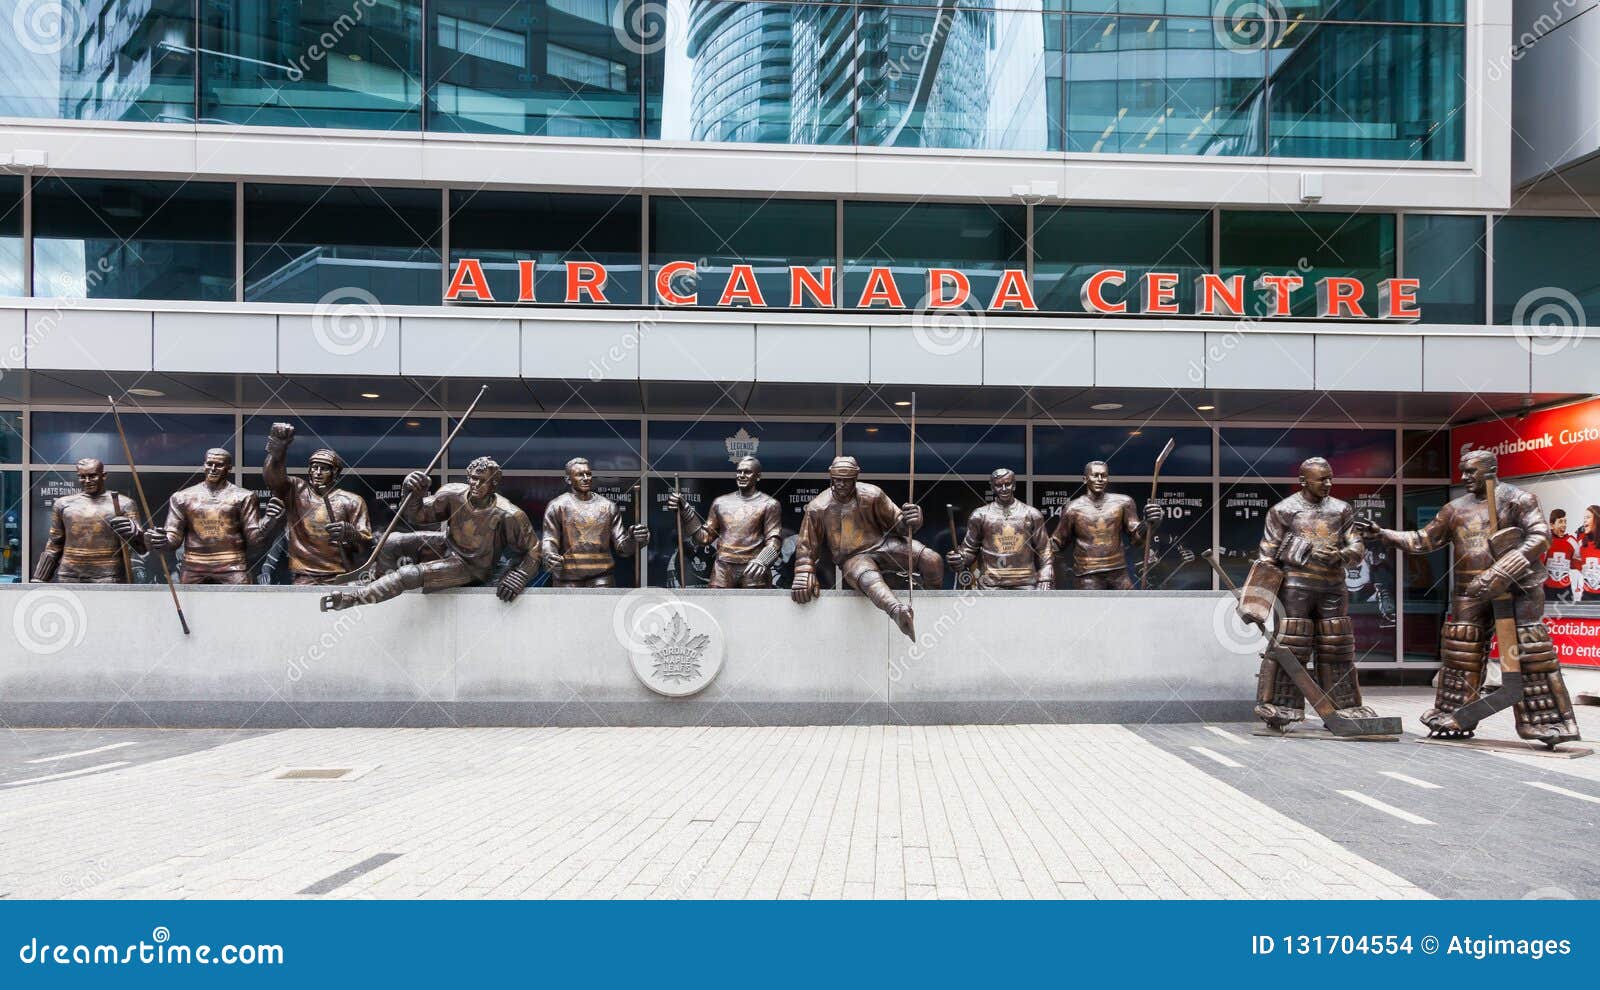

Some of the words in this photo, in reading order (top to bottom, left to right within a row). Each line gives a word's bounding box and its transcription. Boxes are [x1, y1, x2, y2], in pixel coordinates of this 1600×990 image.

[443, 259, 611, 304] AIR
[655, 261, 1039, 312] CANADA
[1080, 270, 1421, 322] CENTRE
[1478, 433, 1553, 457] otiabank
[1166, 506, 1183, 519] 10
[1561, 643, 1574, 656] to
